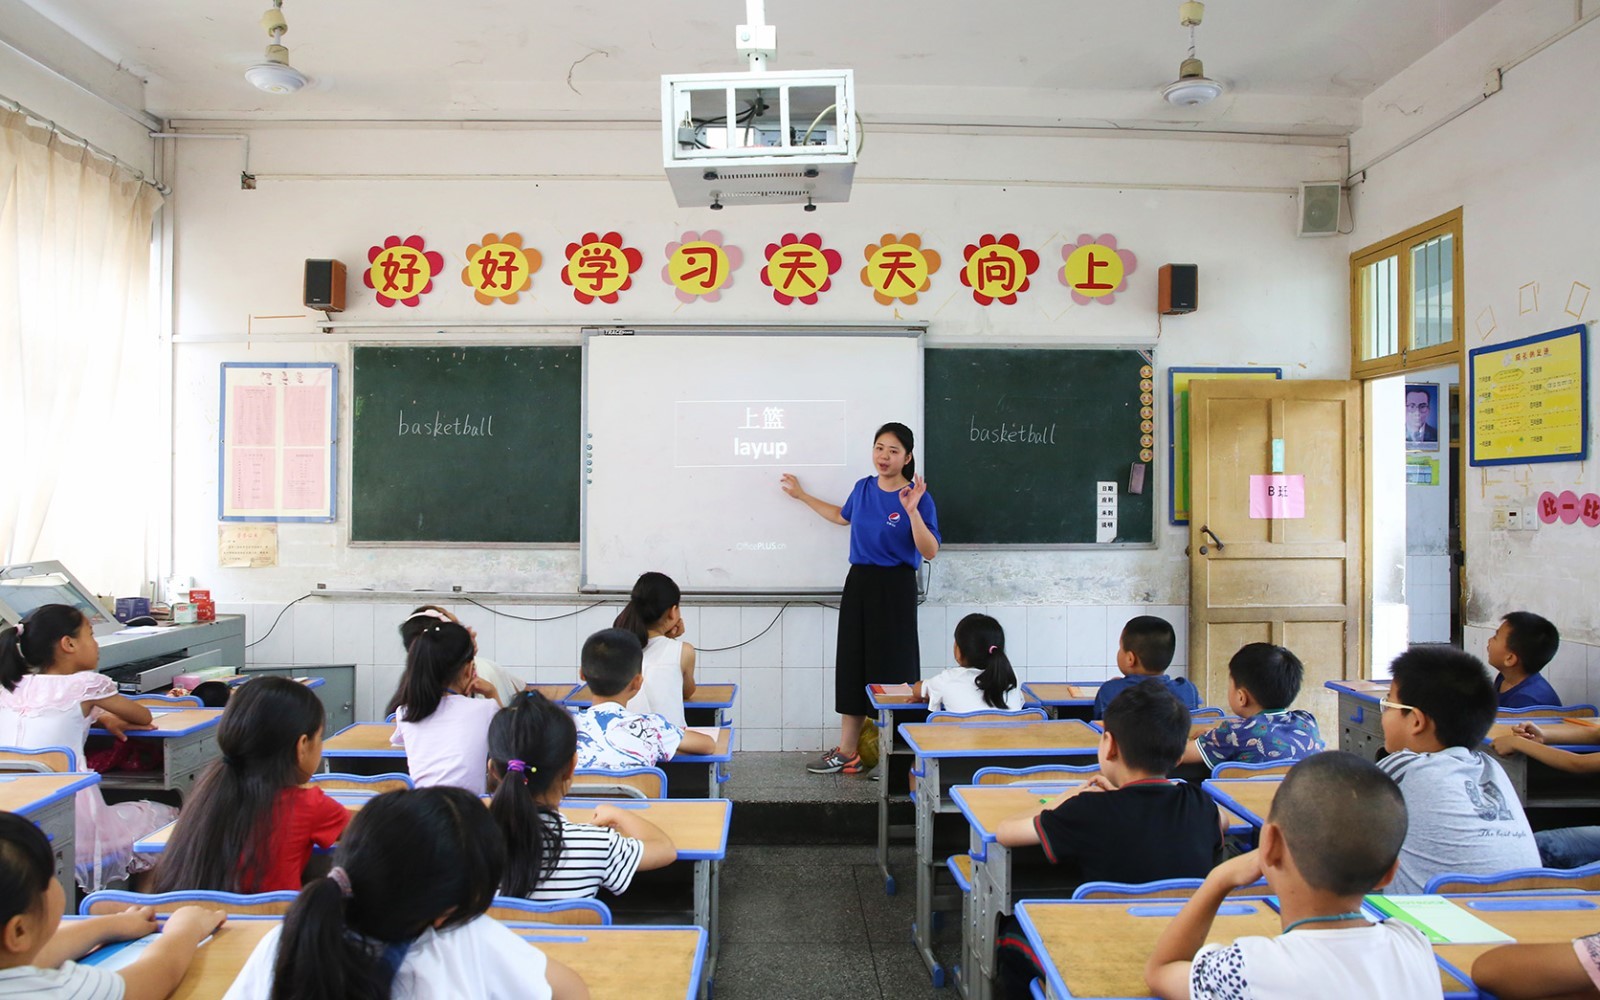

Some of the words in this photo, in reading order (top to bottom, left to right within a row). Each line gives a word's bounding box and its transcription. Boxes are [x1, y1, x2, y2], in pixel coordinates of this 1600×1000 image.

[380, 248, 1114, 292] 好好学习天天向上
[398, 409, 493, 437] basketball
[737, 406, 785, 430] 上篮
[970, 415, 1056, 444] basketball
[733, 437, 788, 459] layup
[1543, 497, 1600, 520] 比一比
[1478, 828, 1494, 837] The
